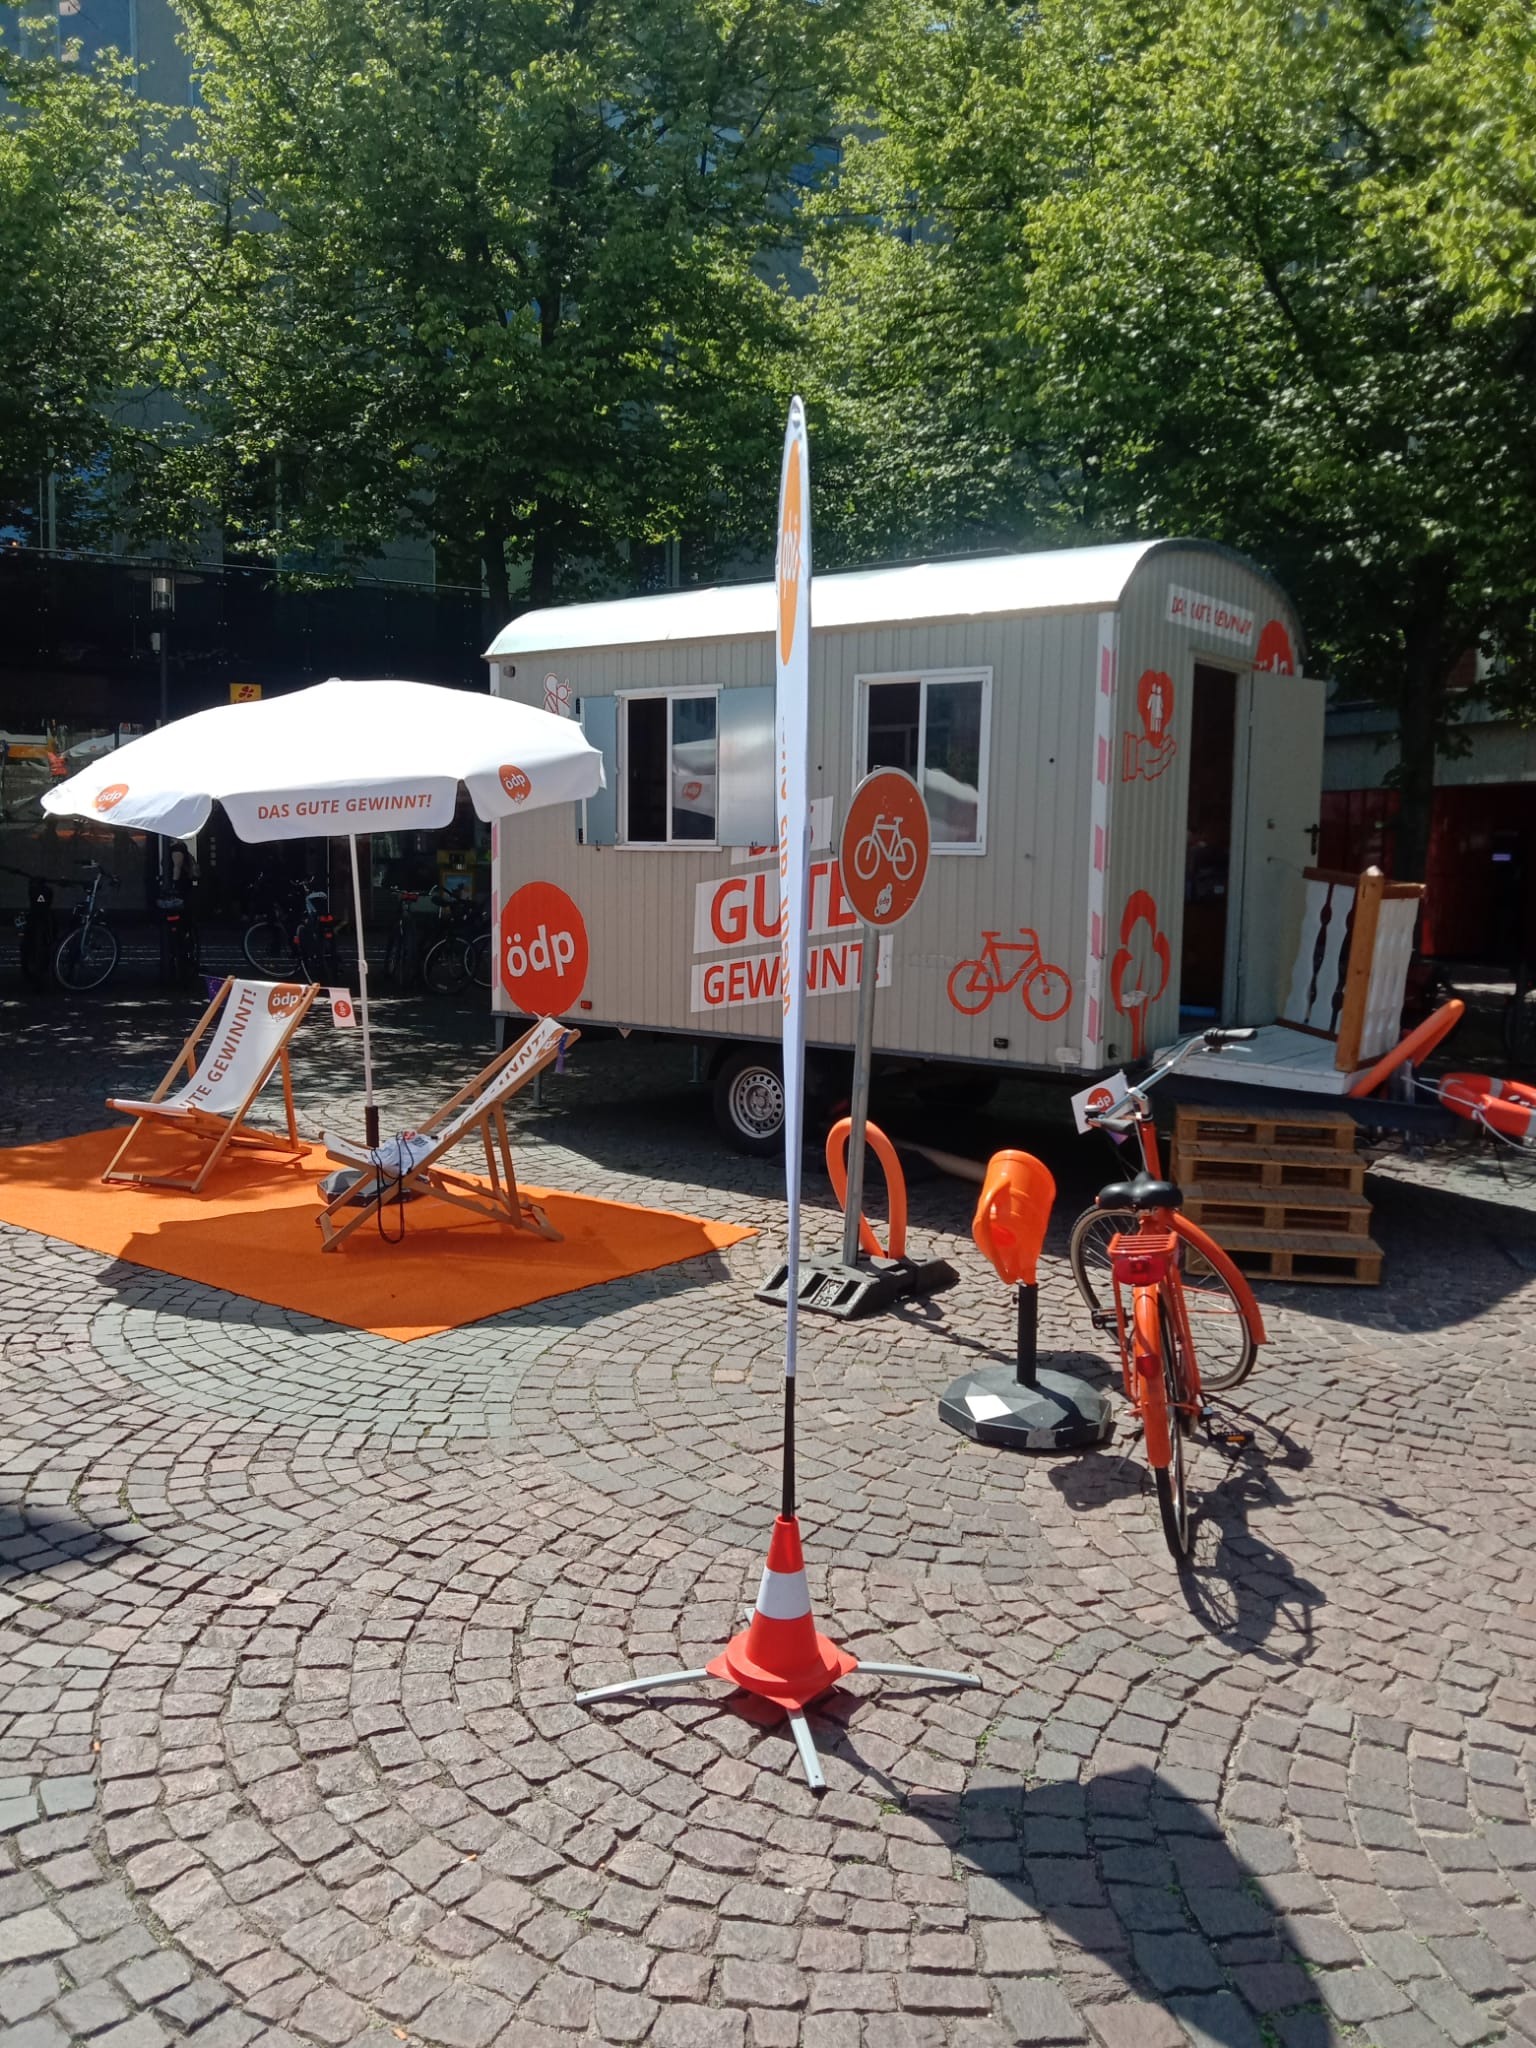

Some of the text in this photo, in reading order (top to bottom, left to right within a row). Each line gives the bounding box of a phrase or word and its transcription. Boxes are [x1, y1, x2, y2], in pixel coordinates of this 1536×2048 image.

[503, 774, 526, 790] ödp
[258, 794, 432, 819] DAS GUTE GEWINNT!
[506, 924, 575, 977] ödp
[272, 992, 299, 1008] ödp
[207, 988, 257, 1082] GEWINNT!
